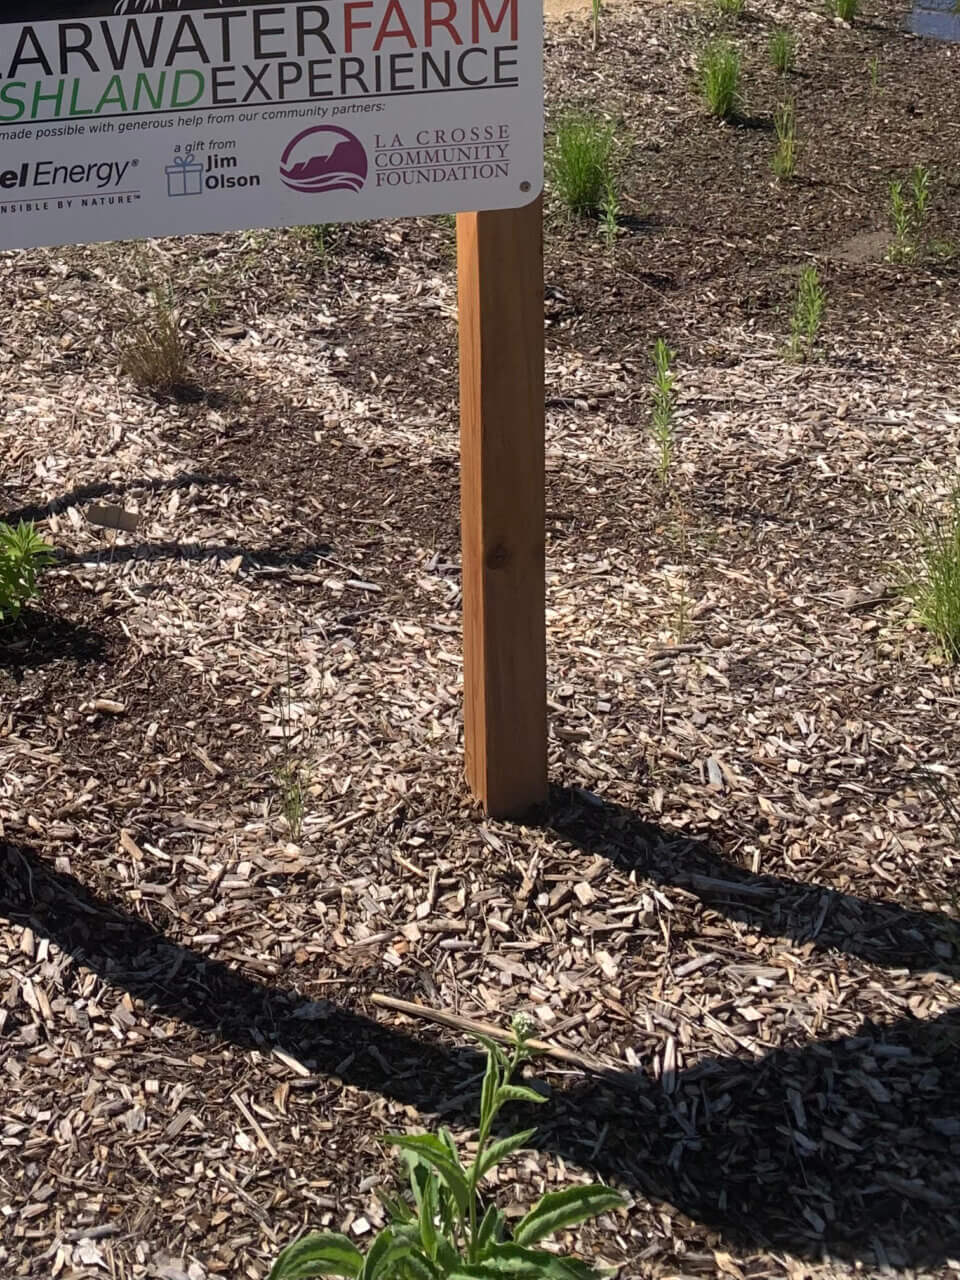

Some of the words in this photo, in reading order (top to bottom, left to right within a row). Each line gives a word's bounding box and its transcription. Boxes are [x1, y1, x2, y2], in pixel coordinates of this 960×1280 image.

[35, 123, 85, 140] possible
[88, 121, 115, 134] with
[118, 118, 174, 134] generous
[177, 115, 203, 127] help
[207, 113, 235, 125] from
[238, 111, 258, 122] our
[261, 104, 329, 121] community
[331, 102, 386, 118] partners:
[174, 144, 181, 153] a
[184, 140, 205, 154] gift
[208, 139, 236, 151] from
[374, 133, 404, 149] LA
[416, 124, 510, 146] CROSSE
[205, 153, 237, 173] Jim
[374, 143, 510, 168] COMMUNITY
[205, 174, 261, 190] Olson
[375, 162, 510, 188] FOUNDATION
[57, 199, 73, 210] BY
